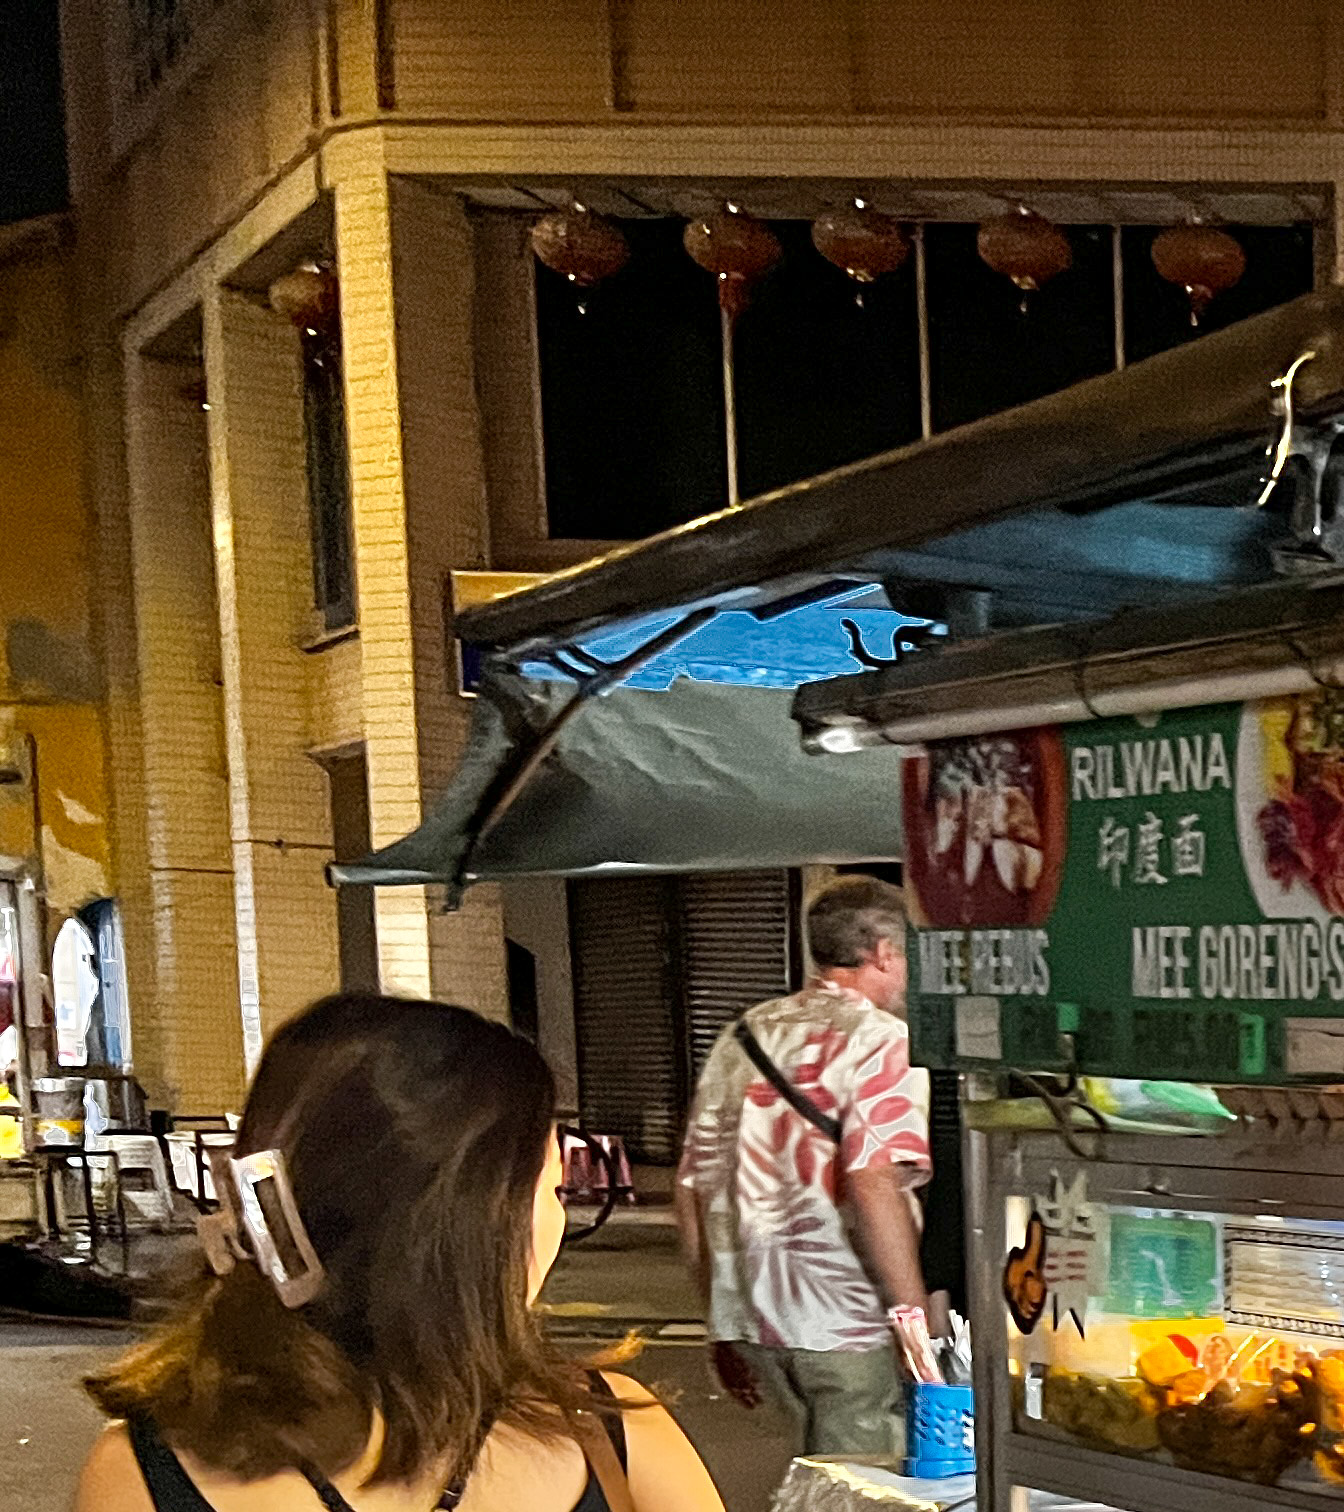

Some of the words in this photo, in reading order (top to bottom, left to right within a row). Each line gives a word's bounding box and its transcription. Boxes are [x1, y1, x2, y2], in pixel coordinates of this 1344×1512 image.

[1070, 732, 1234, 800] RILWANA
[919, 930, 967, 995] MEE
[1132, 926, 1192, 998] MEE
